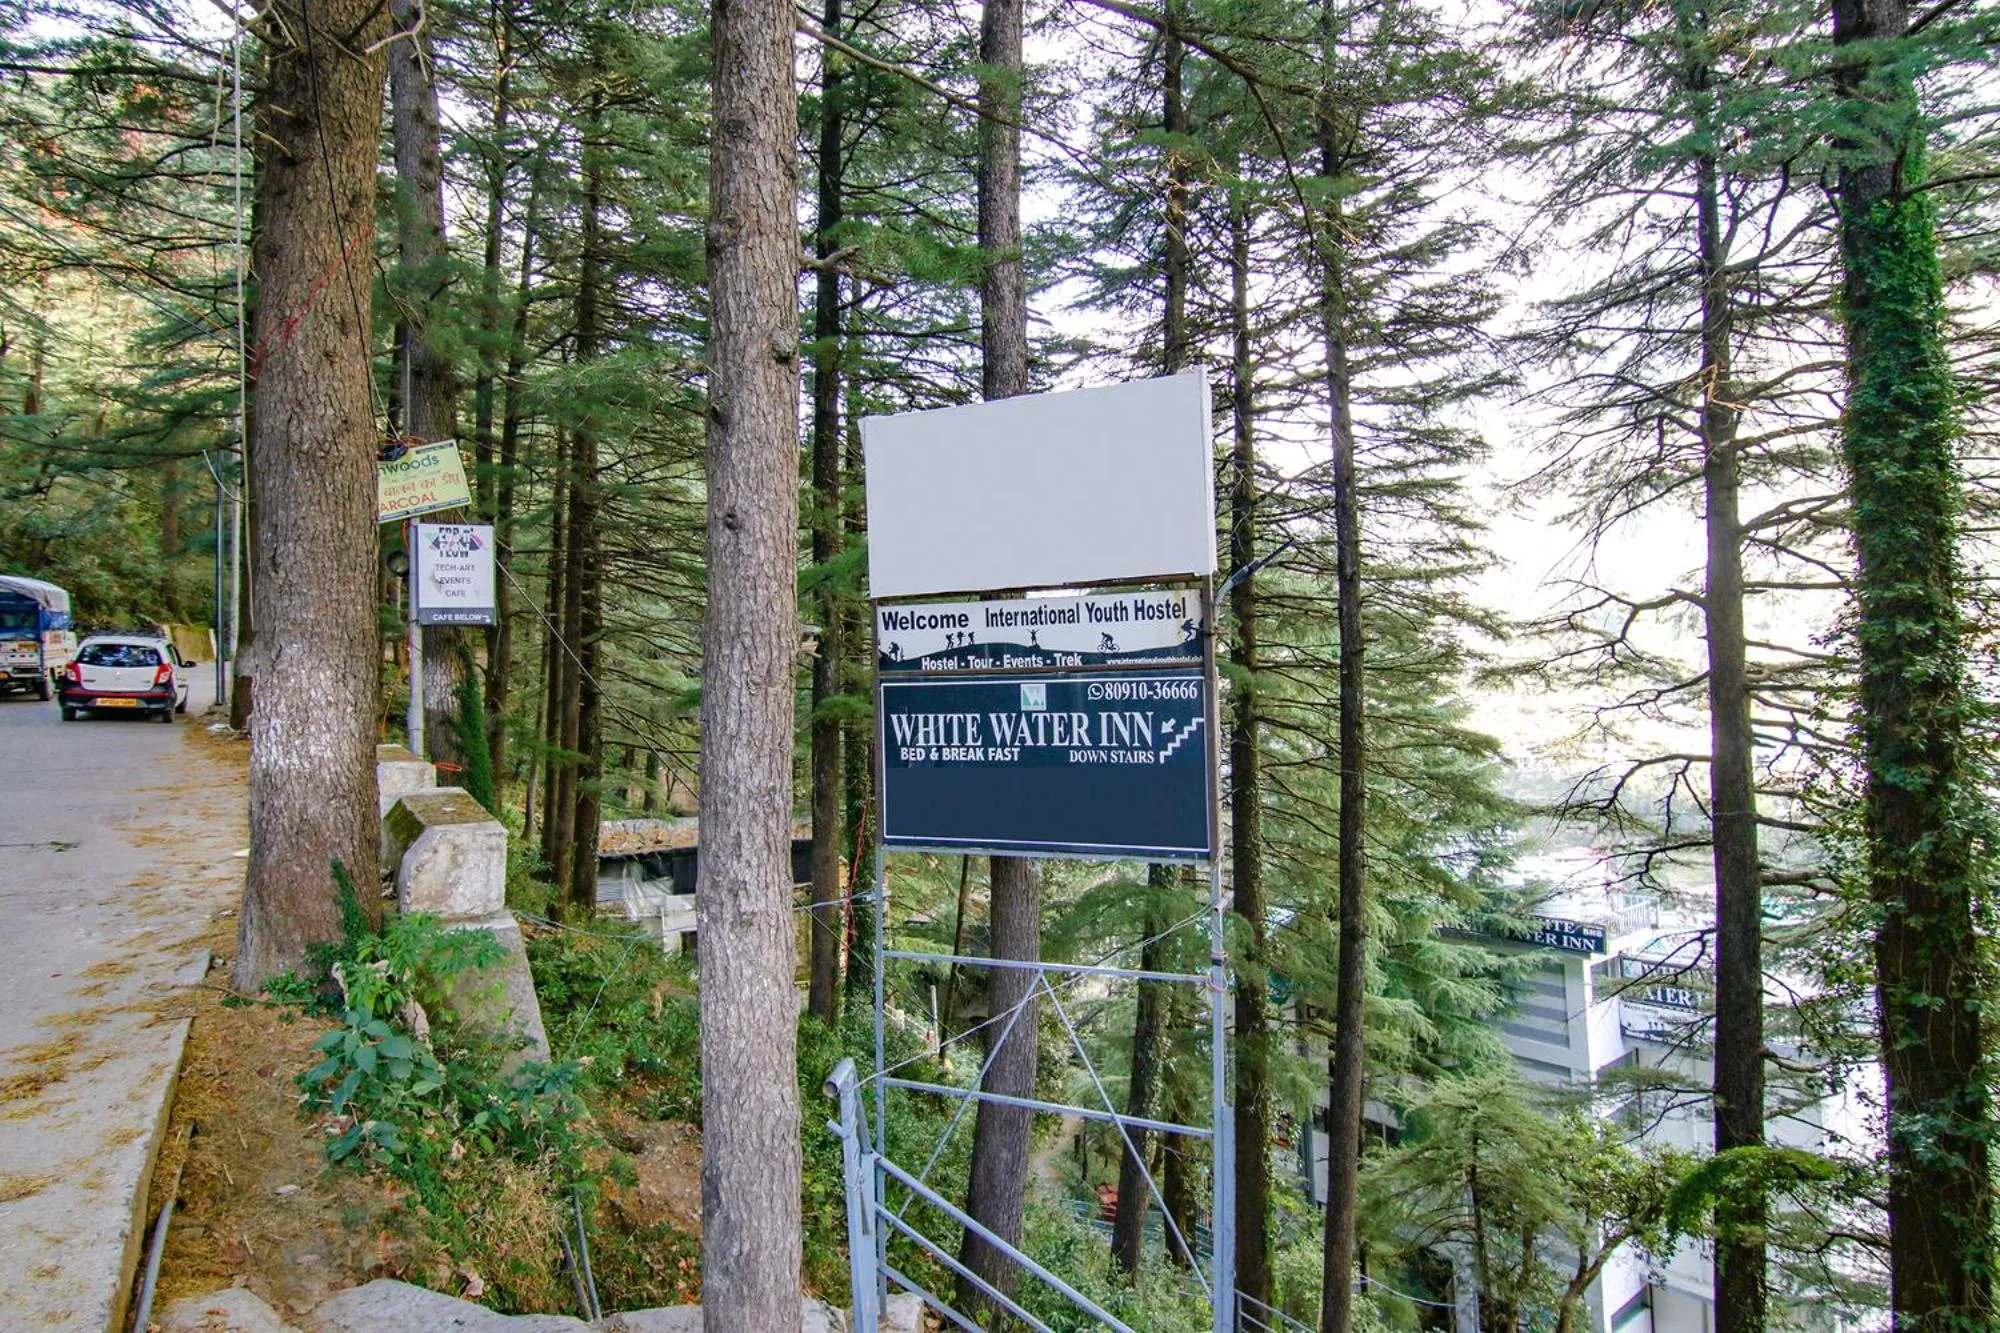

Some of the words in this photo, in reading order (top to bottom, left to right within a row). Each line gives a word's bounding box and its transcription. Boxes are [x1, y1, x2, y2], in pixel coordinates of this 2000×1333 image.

[440, 576, 472, 585] EVENTS
[445, 589, 466, 597] CAFE
[432, 613, 453, 621] CAFE
[454, 613, 481, 621] BELOW
[882, 611, 969, 631] Welcome
[985, 603, 1080, 628] International
[1085, 600, 1128, 623] Youth
[1134, 597, 1186, 621] Hostel
[921, 656, 958, 671] Hostel
[967, 655, 994, 669] Tour
[1003, 653, 1043, 669] Events
[1054, 652, 1082, 667] Trek
[1105, 681, 1198, 700] 80910-36666
[890, 713, 982, 746] WHITE
[989, 712, 1092, 746] WATER
[1098, 711, 1154, 747] INN
[900, 747, 926, 761] BED
[929, 747, 940, 761] &
[942, 747, 985, 761] BREAK
[988, 747, 1020, 761] FAST
[1069, 750, 1107, 763] DOWN
[1110, 750, 1154, 764] STAIRS
[1545, 919, 1576, 934] ITE
[1562, 935, 1595, 951] INN
